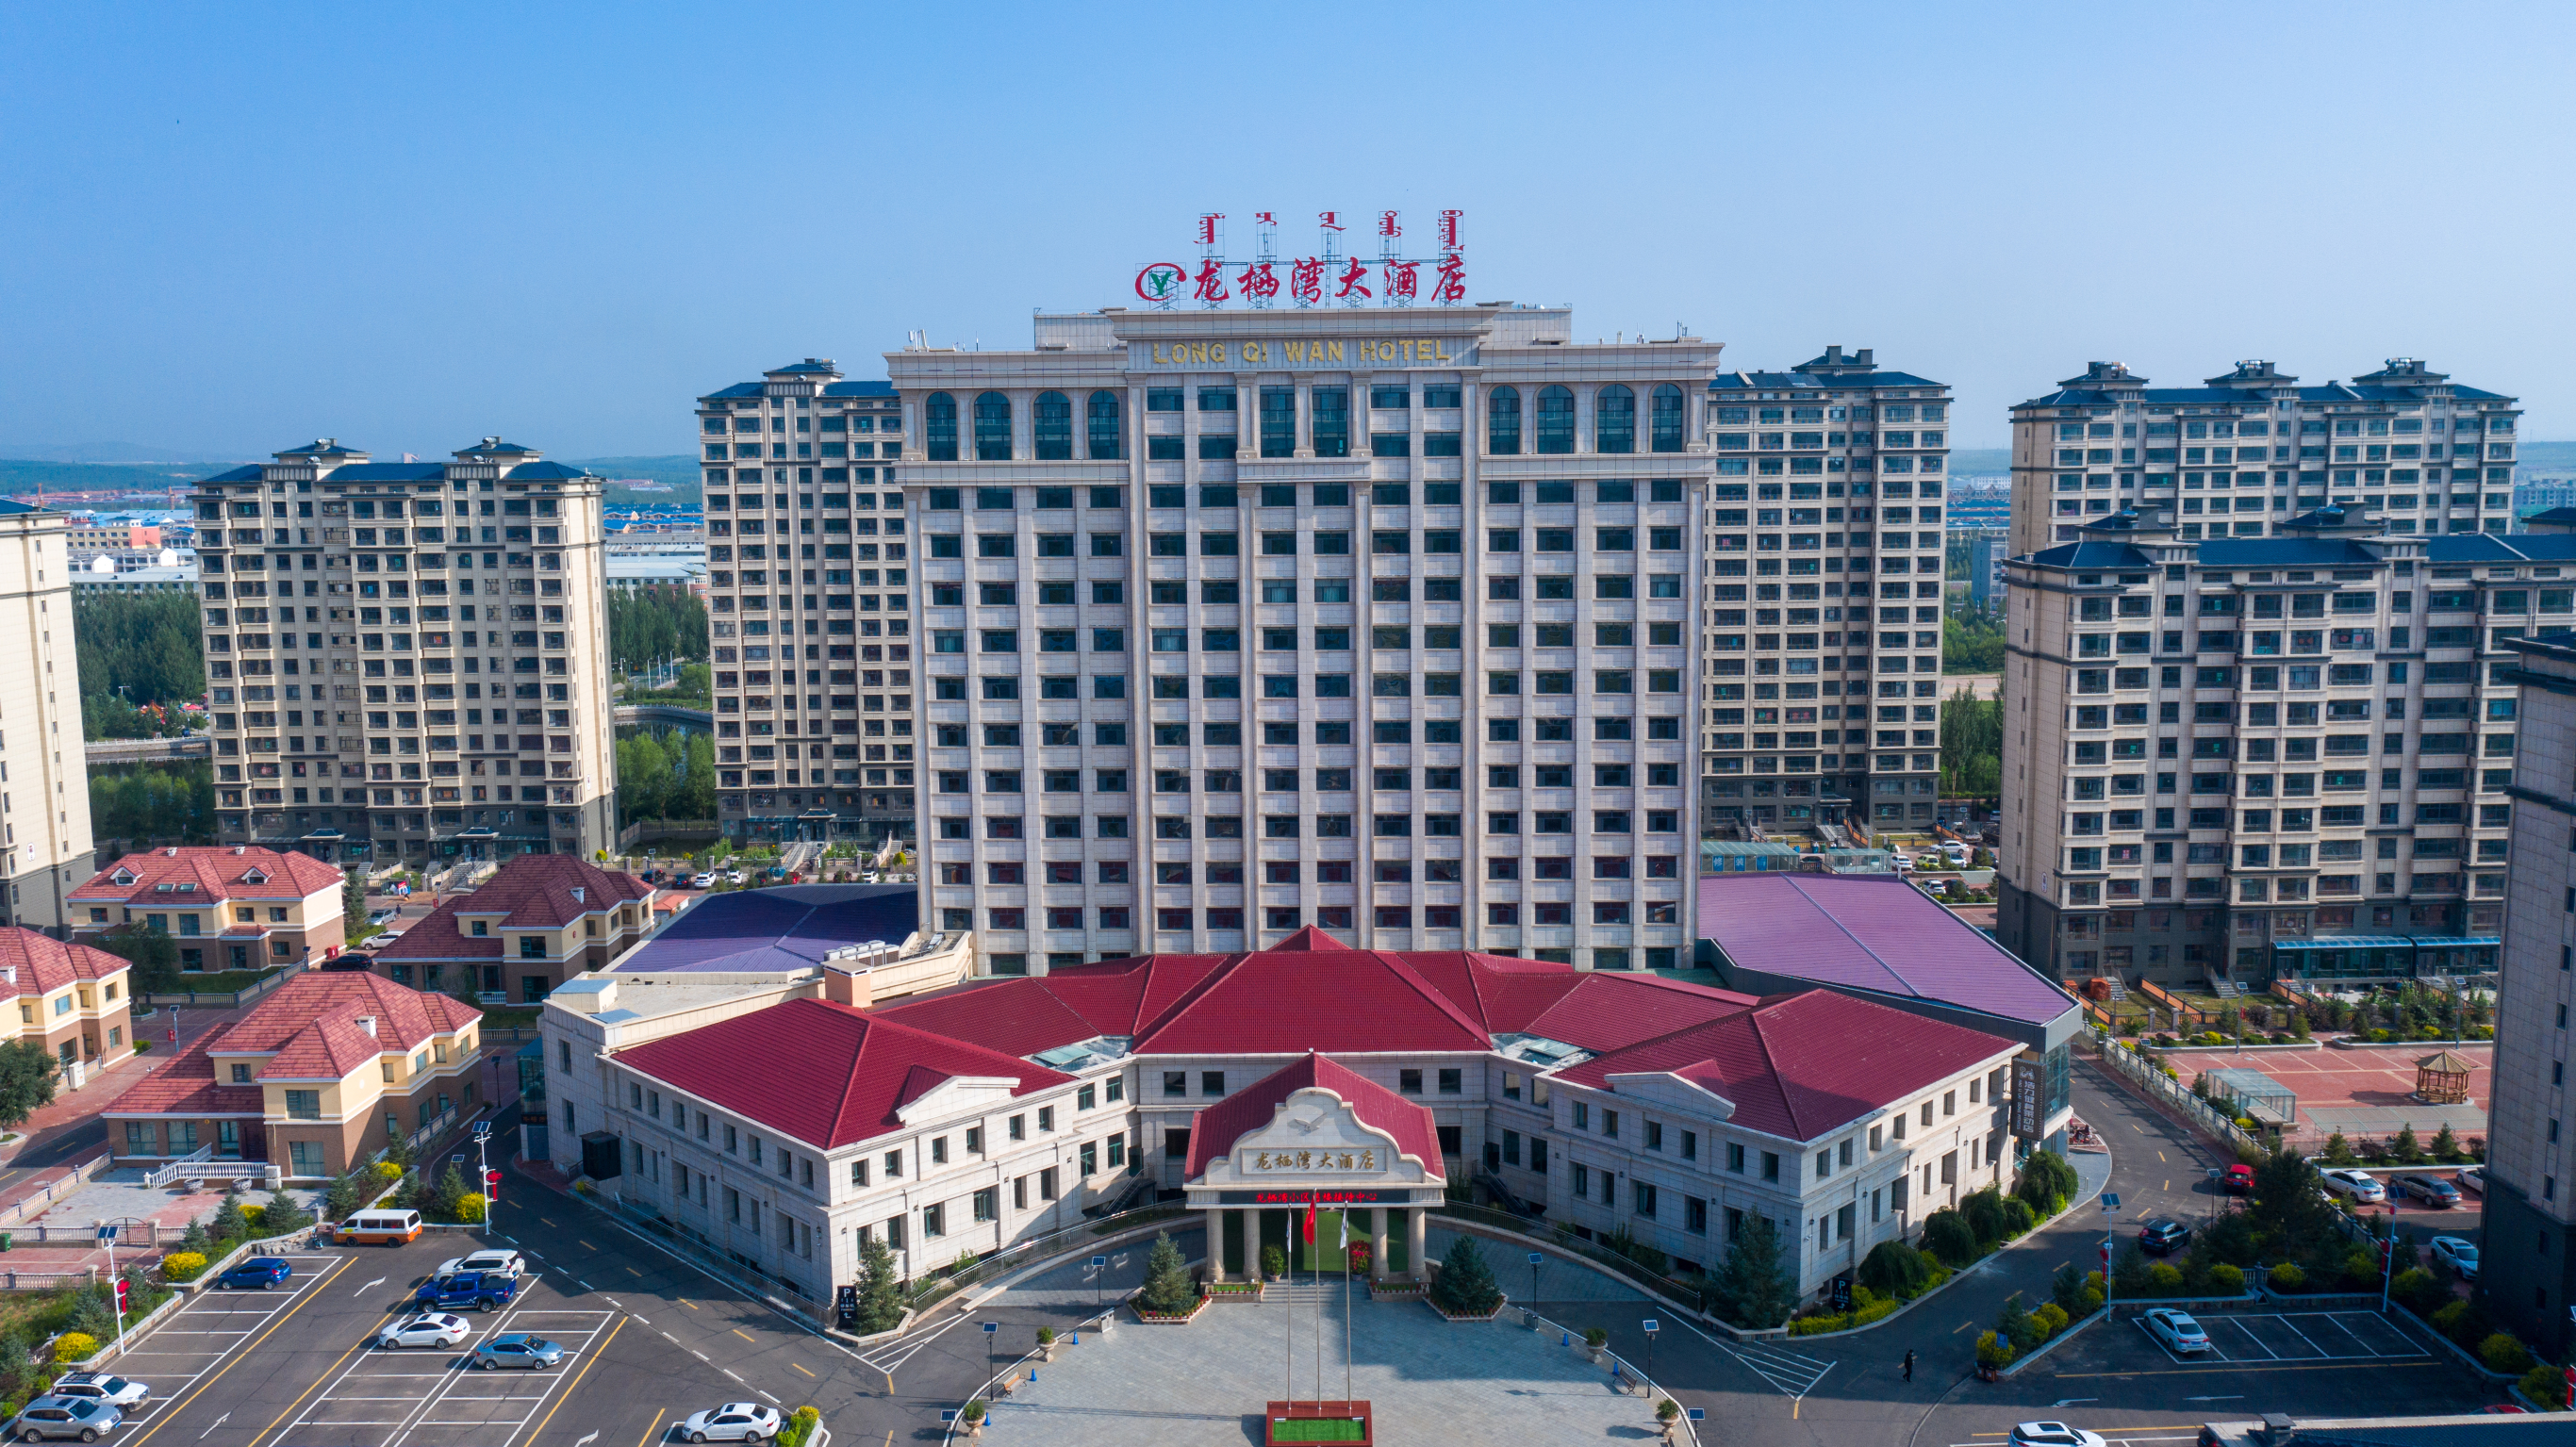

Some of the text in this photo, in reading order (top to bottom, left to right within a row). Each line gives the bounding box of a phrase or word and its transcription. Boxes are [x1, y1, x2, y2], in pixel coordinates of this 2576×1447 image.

[1194, 254, 1466, 304] 龙栖湾大酒店
[1153, 339, 1450, 365] LONG QI WAN HOTEL
[1256, 1150, 1375, 1170] 龙栖湾大酒店
[843, 1288, 850, 1297] P
[1839, 1280, 1846, 1290] P
